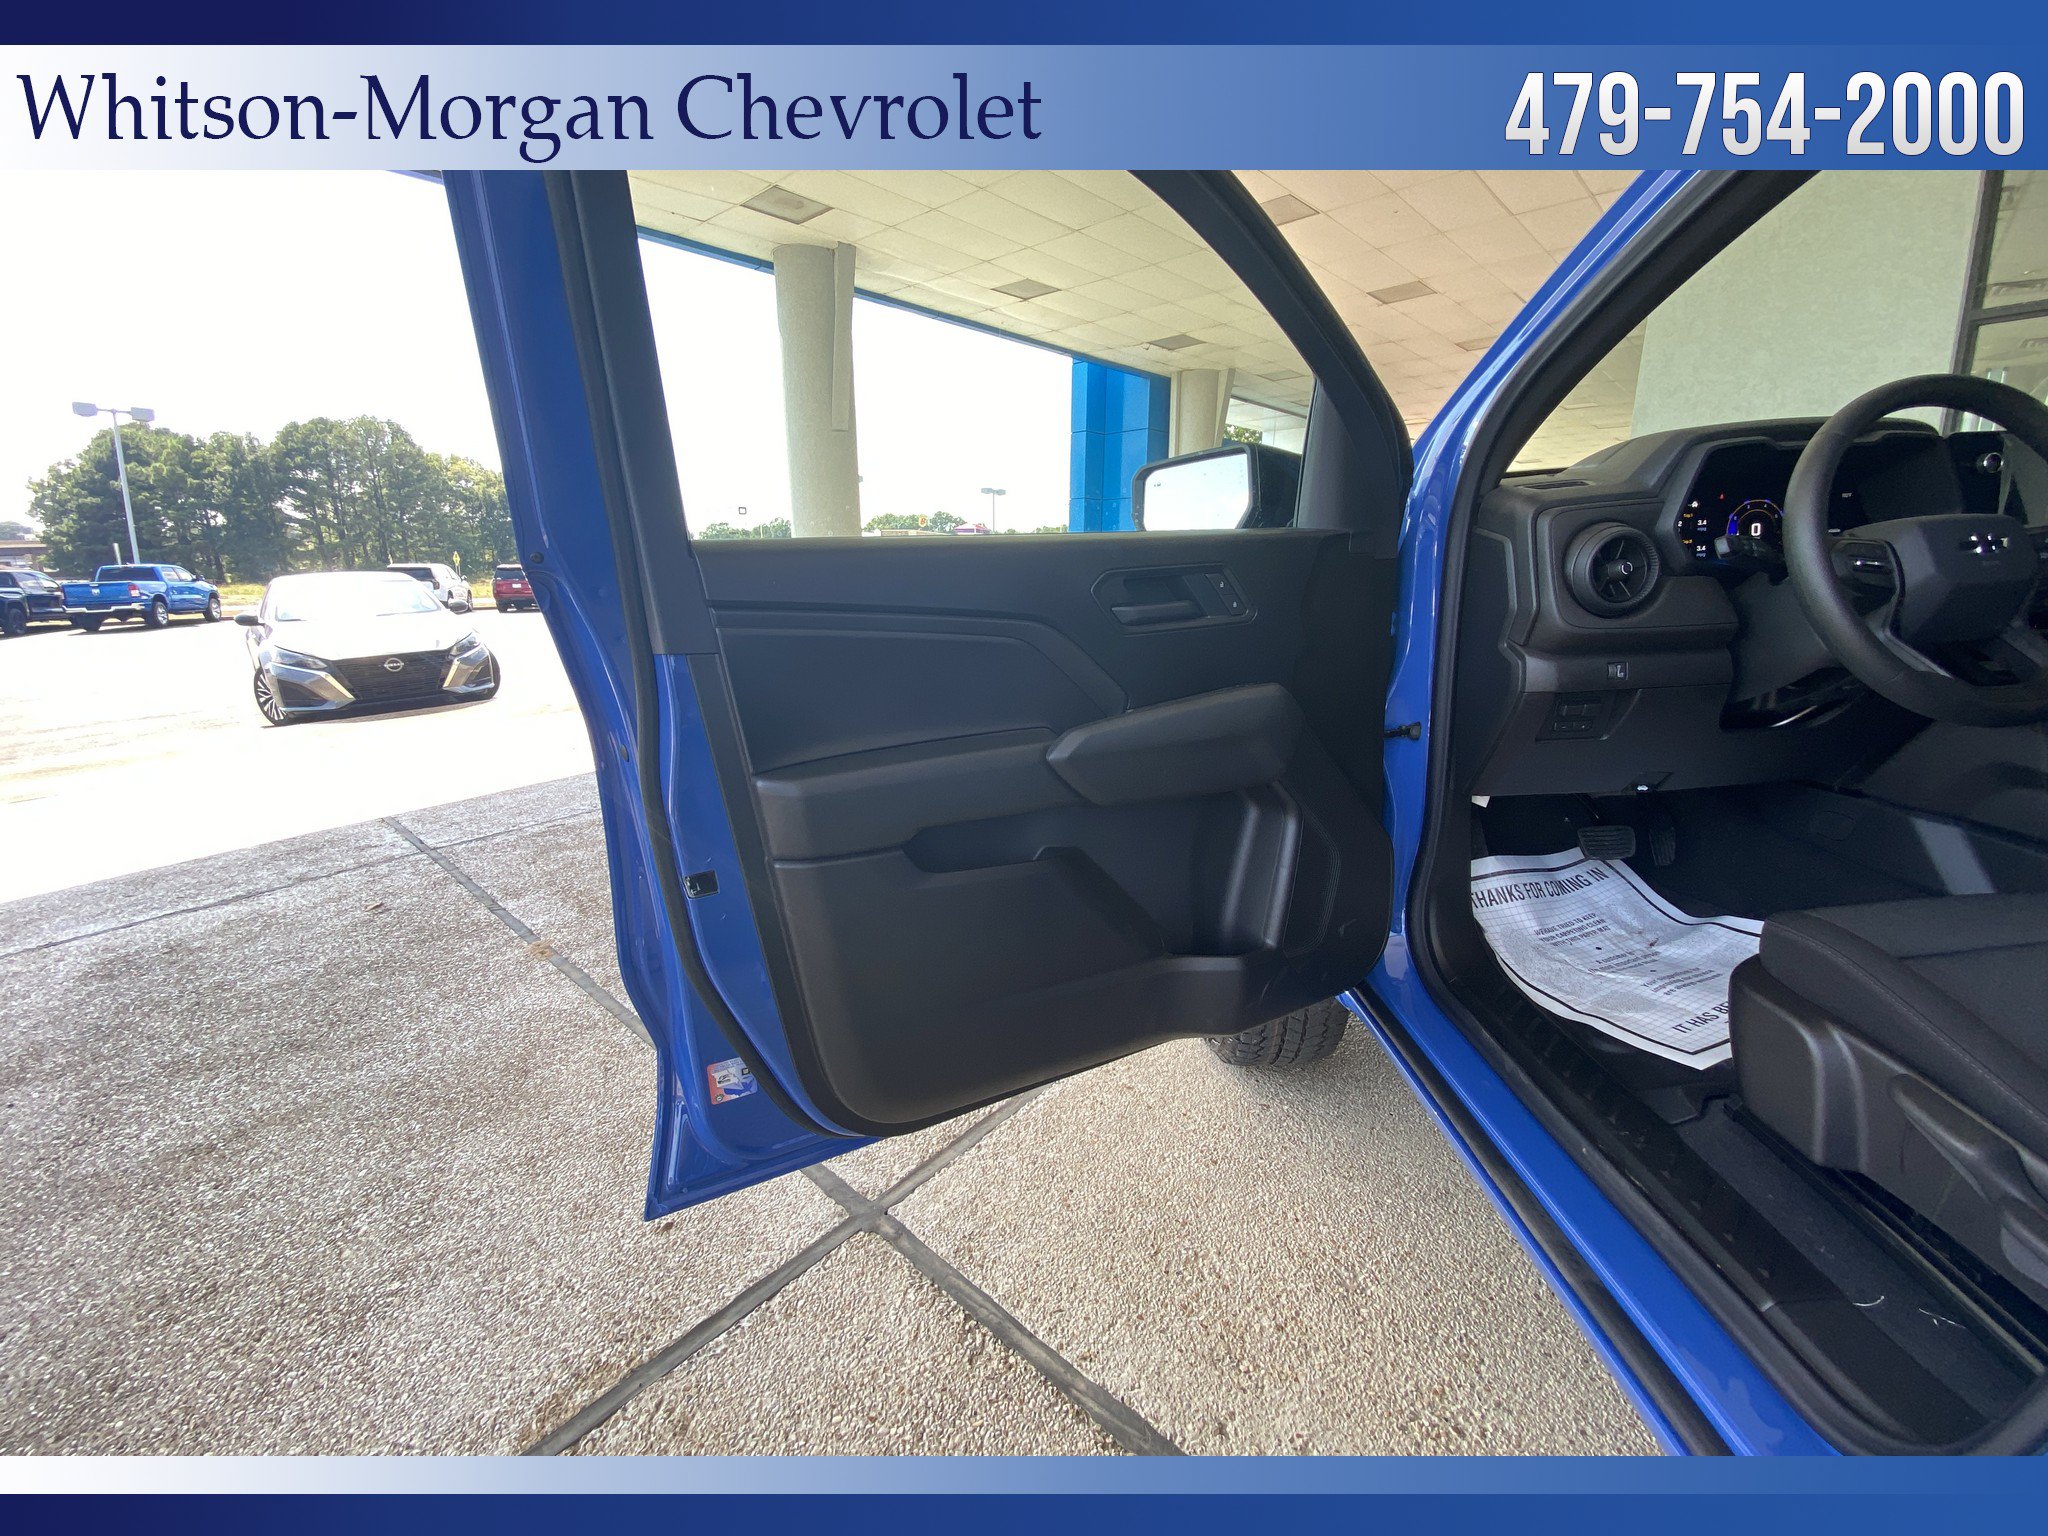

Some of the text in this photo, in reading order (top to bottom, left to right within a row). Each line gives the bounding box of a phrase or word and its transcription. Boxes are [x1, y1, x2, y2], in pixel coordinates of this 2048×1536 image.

[1751, 522, 1761, 537] 0
[1471, 867, 1610, 909] THANKS FOR COMING IN
[1582, 912, 1597, 921] KEEP
[1671, 1023, 1693, 1034] IT
[1685, 1011, 1720, 1028] HAS
